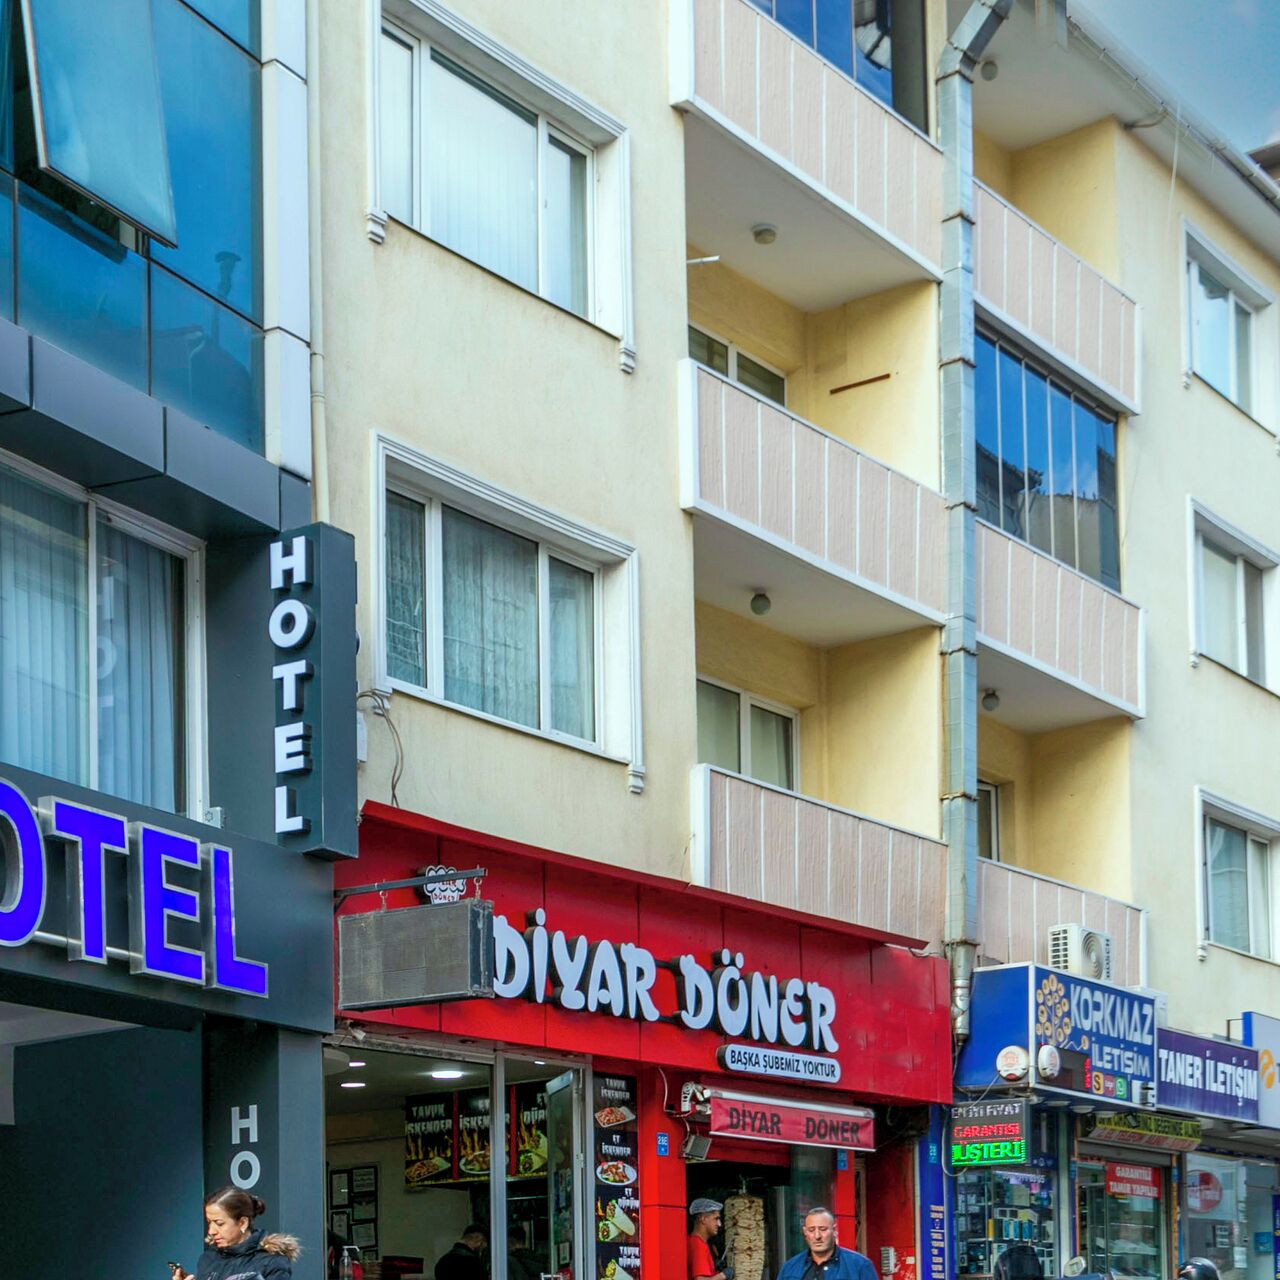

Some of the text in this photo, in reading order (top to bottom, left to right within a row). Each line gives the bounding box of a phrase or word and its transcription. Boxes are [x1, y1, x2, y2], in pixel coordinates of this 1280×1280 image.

[269, 534, 314, 832] HOTEL
[493, 907, 840, 1054] DİYAR DÖNER
[1070, 983, 1154, 1047] KORKMAZ
[730, 1049, 837, 1078] BAŞKA ŞUBEMİZ YOKTUR
[1159, 1048, 1258, 1107] TANER İLETİŞİM
[412, 1103, 445, 1120] TAVUK
[728, 1104, 782, 1136] DİYAR
[230, 1104, 261, 1190] HO
